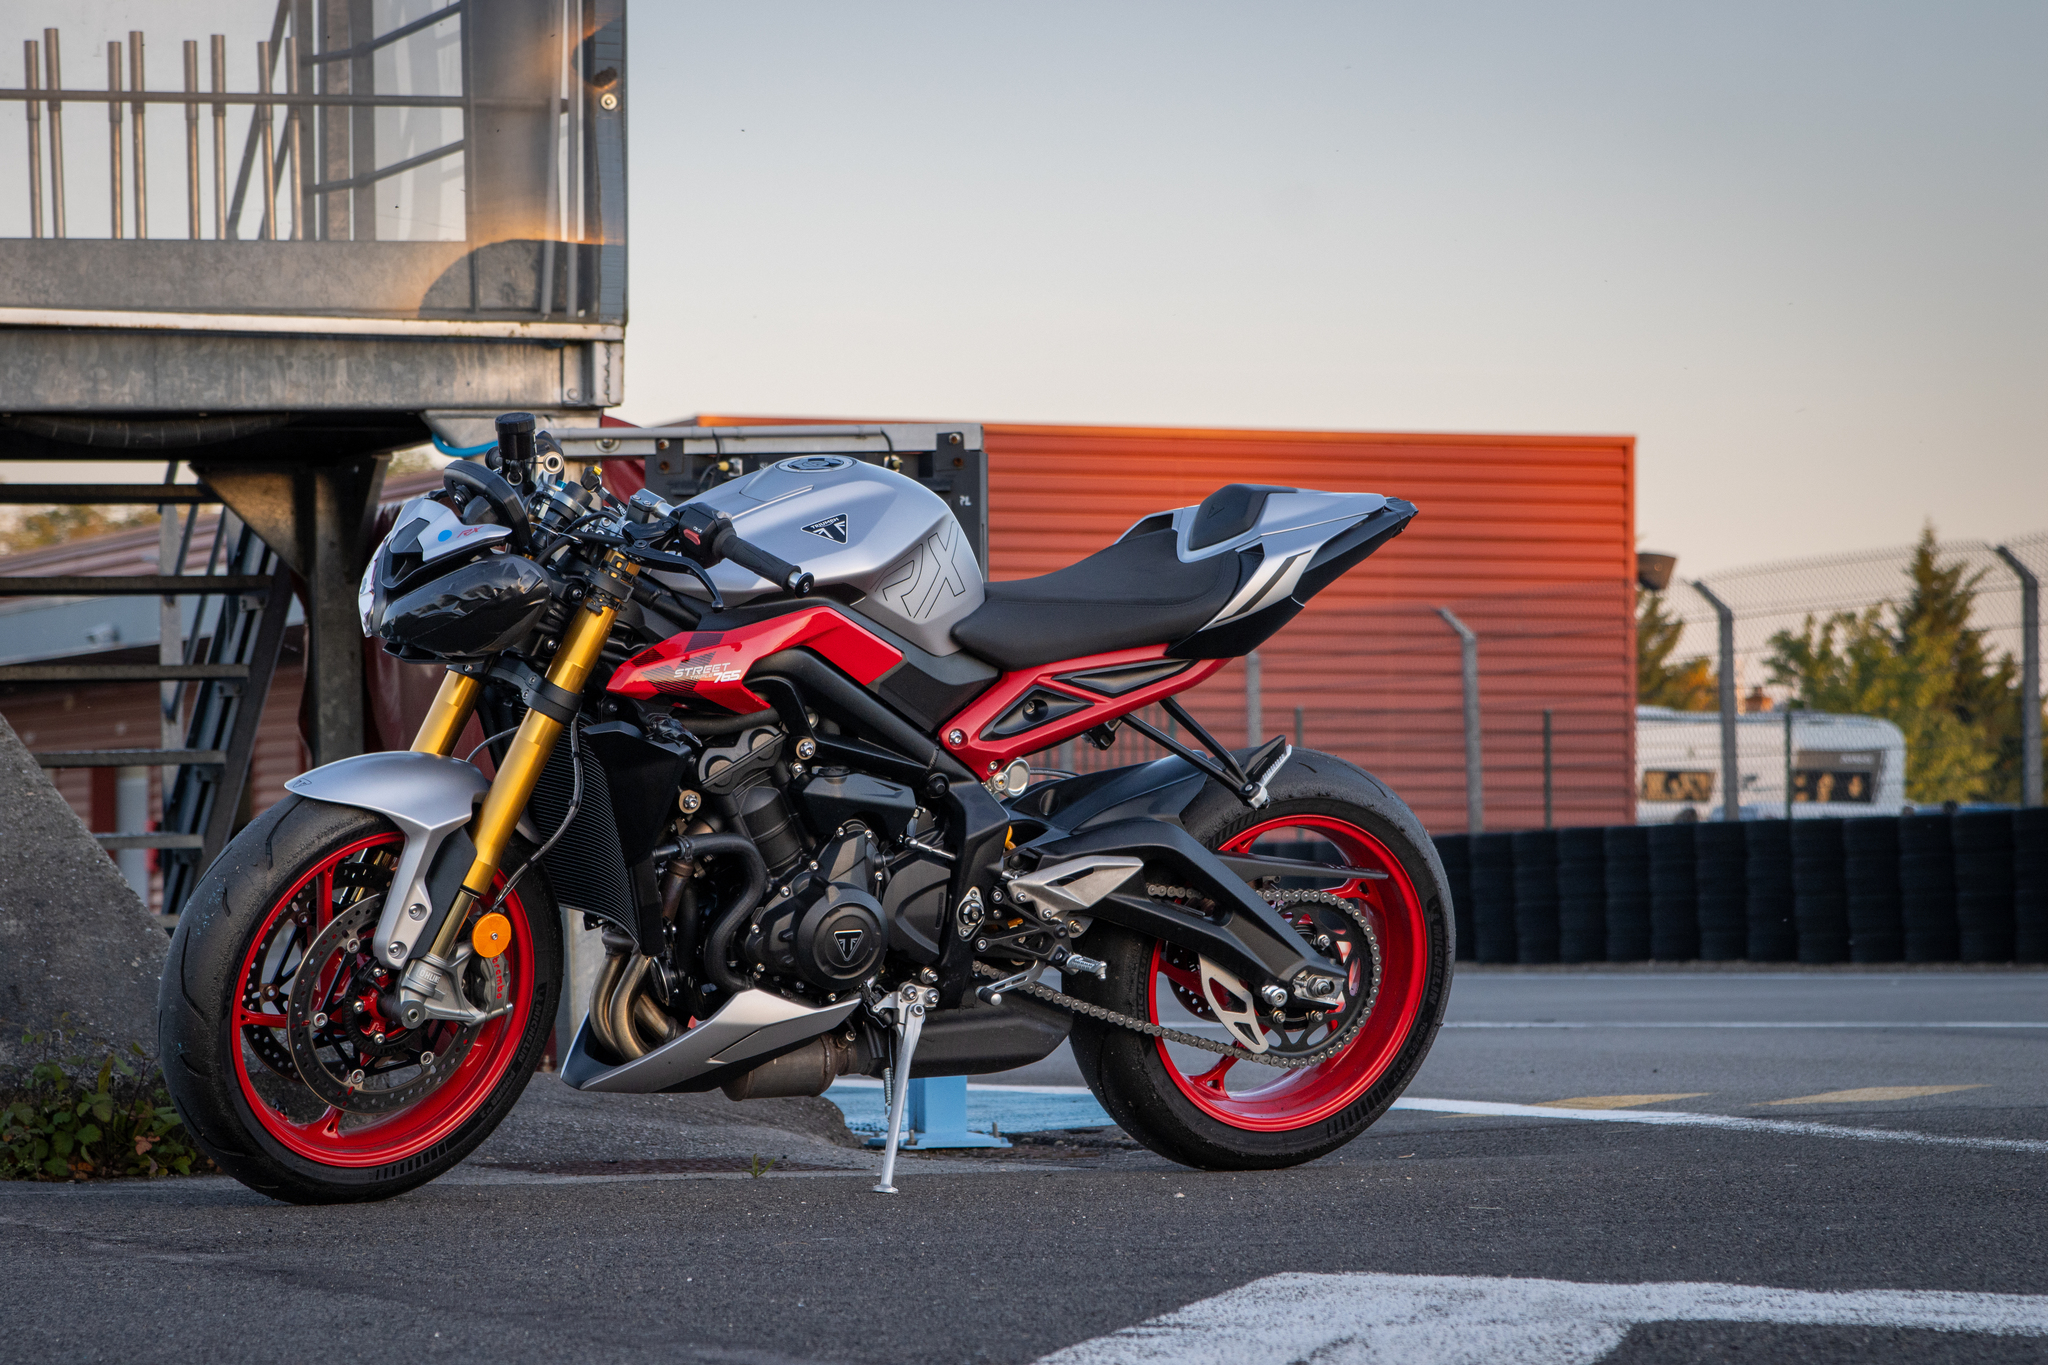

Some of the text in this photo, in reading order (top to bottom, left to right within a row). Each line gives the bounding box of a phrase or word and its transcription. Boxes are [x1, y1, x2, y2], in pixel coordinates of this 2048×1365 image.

[810, 517, 840, 529] TRIUMPH
[673, 662, 731, 678] STREET
[713, 669, 742, 684] 765
[492, 955, 506, 1000] brembo
[1428, 924, 1444, 1007] MICHELIN
[517, 1002, 543, 1063] MICHELIN
